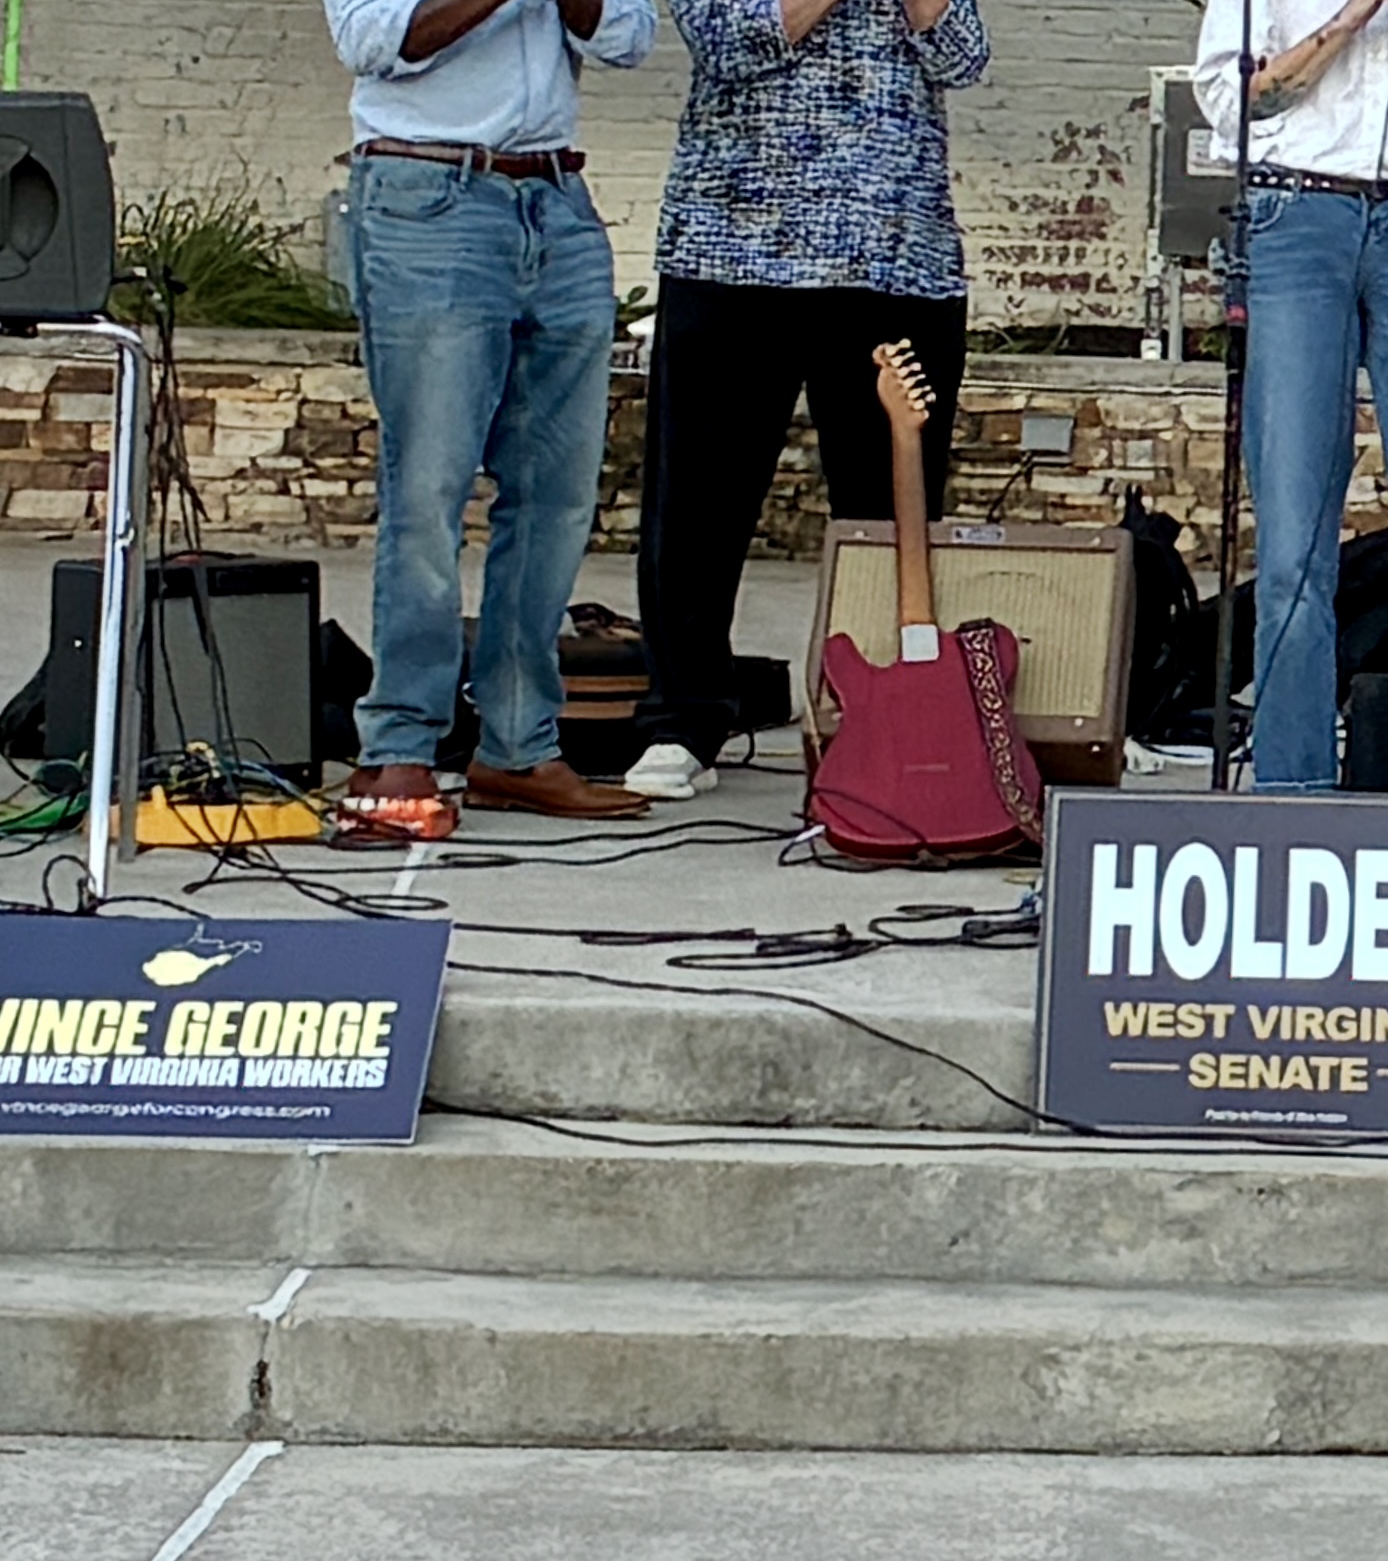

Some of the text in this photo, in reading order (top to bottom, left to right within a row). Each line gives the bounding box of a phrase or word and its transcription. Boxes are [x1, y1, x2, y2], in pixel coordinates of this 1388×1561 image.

[164, 1000, 398, 1058] GEORGE
[1104, 1002, 1235, 1038] WEST
[25, 1055, 108, 1085] WEST
[110, 1056, 238, 1087] VIRGINIA
[244, 1058, 388, 1088] WORKERS
[1188, 1053, 1369, 1092] SENATE
